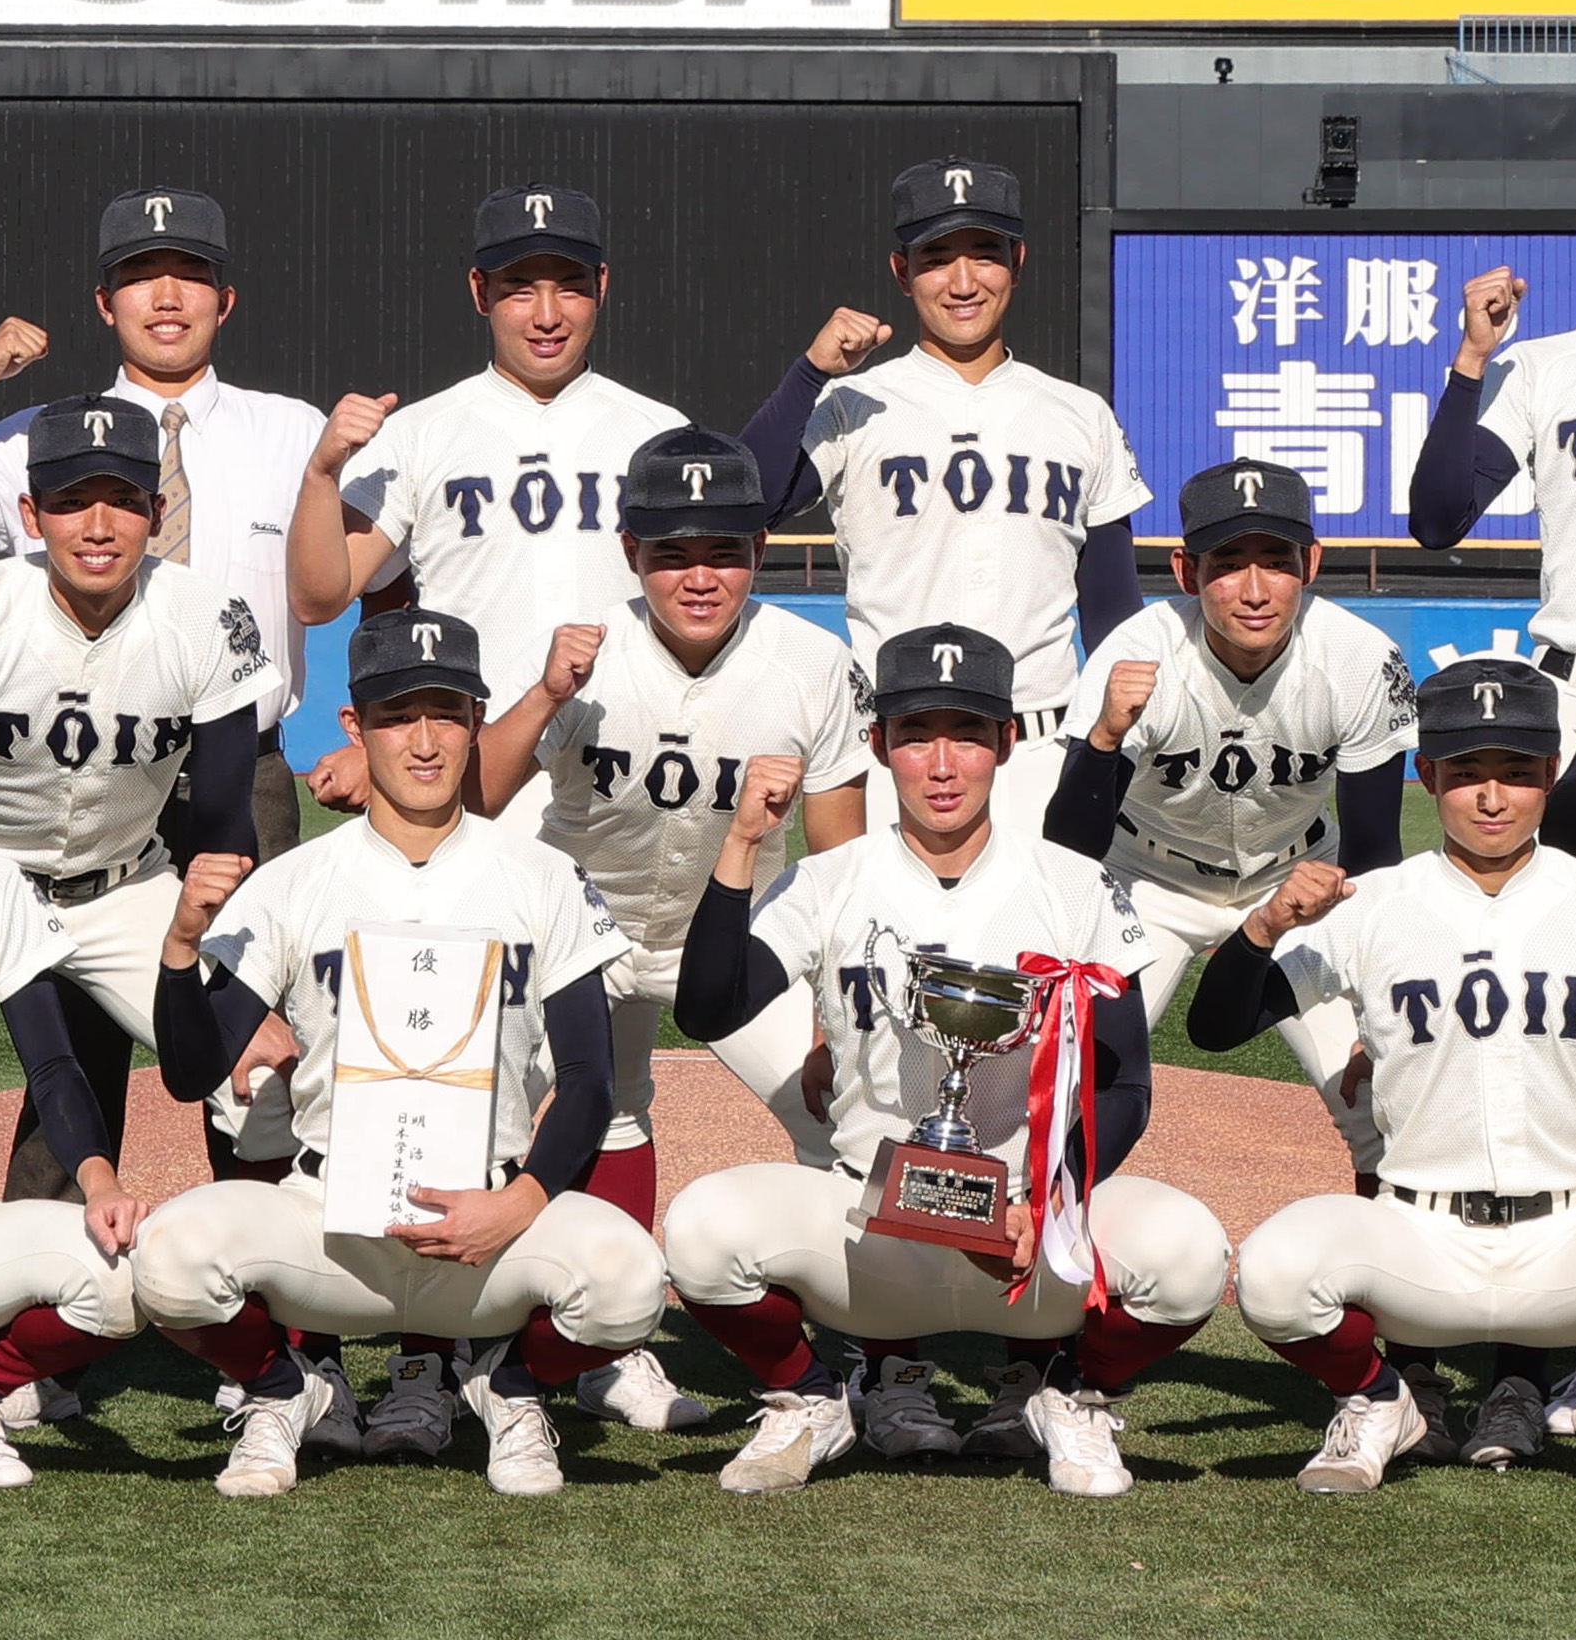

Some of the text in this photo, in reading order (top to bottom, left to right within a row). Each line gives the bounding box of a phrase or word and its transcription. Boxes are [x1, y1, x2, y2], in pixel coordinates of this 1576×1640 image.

[1228, 256, 1518, 347] 洋服
[1234, 469, 1265, 509] T
[231, 652, 272, 684] OSAK
